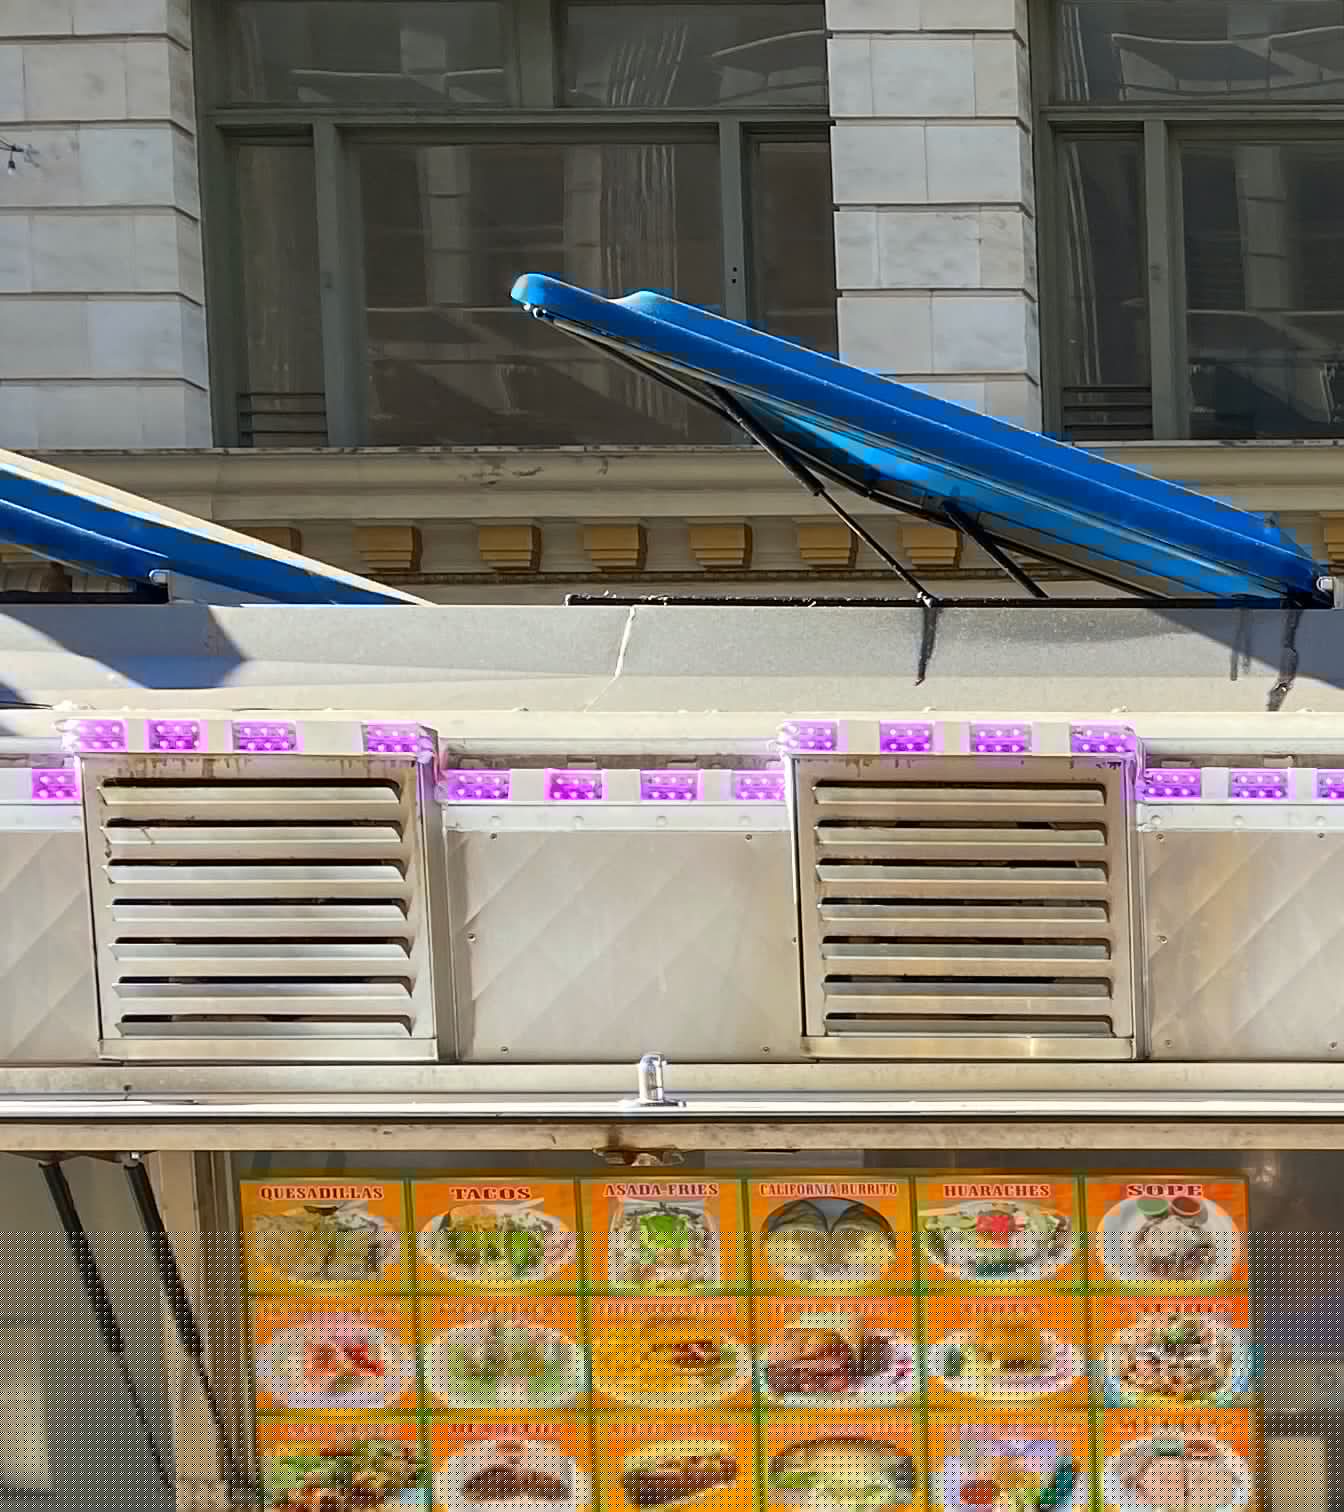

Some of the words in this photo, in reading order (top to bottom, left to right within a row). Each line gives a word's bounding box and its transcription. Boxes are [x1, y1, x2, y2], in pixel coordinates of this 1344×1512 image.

[260, 1185, 384, 1200] QUESADILLAS
[449, 1187, 531, 1200] TACOS
[605, 1183, 661, 1196] ASADA
[668, 1183, 719, 1196] FRIES
[760, 1183, 836, 1196] CALIFORNIA
[840, 1183, 898, 1196] BURRITO
[944, 1185, 1050, 1198] HUARACHES
[1127, 1184, 1202, 1197] SOPE
